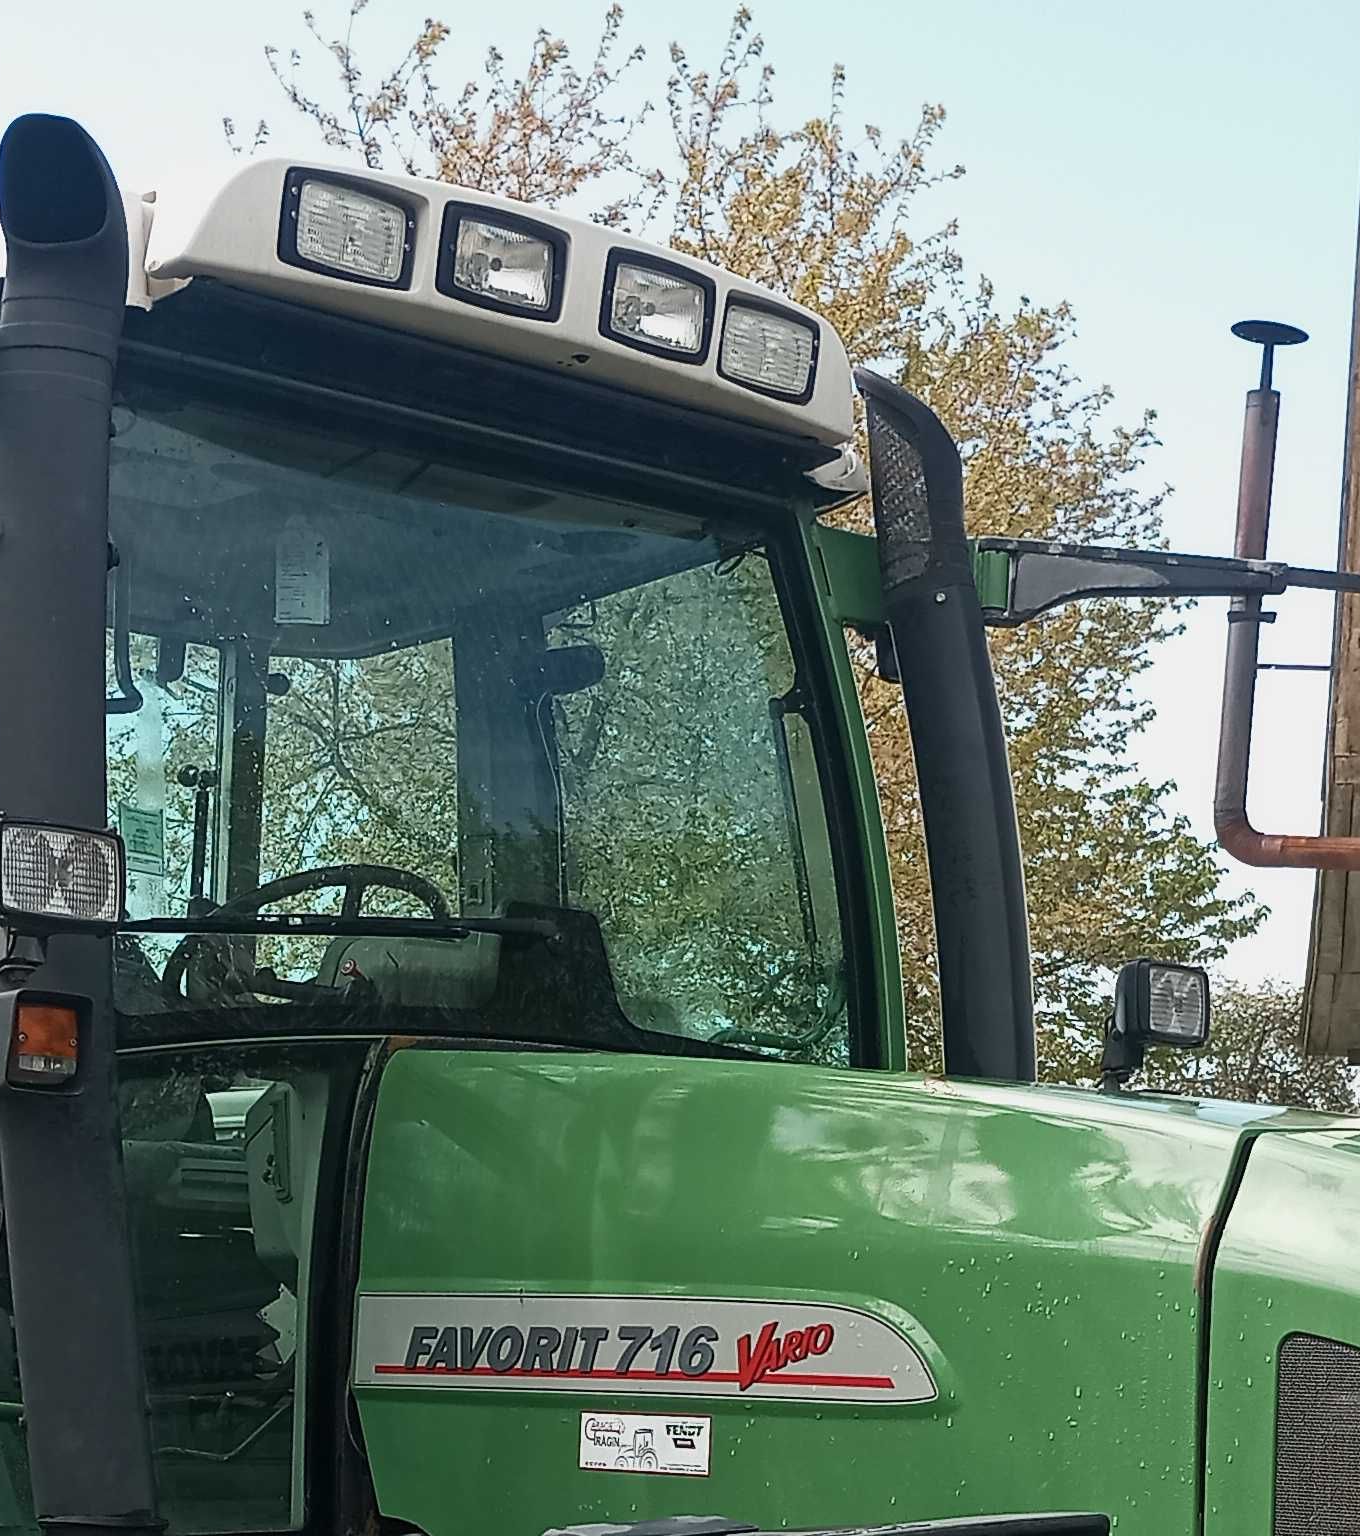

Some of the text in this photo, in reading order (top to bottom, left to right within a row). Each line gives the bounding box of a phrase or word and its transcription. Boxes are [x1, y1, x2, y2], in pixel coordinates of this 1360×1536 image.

[403, 1325, 609, 1373] FAVORIT
[615, 1325, 719, 1377] 716
[665, 1424, 704, 1437] FENDT
